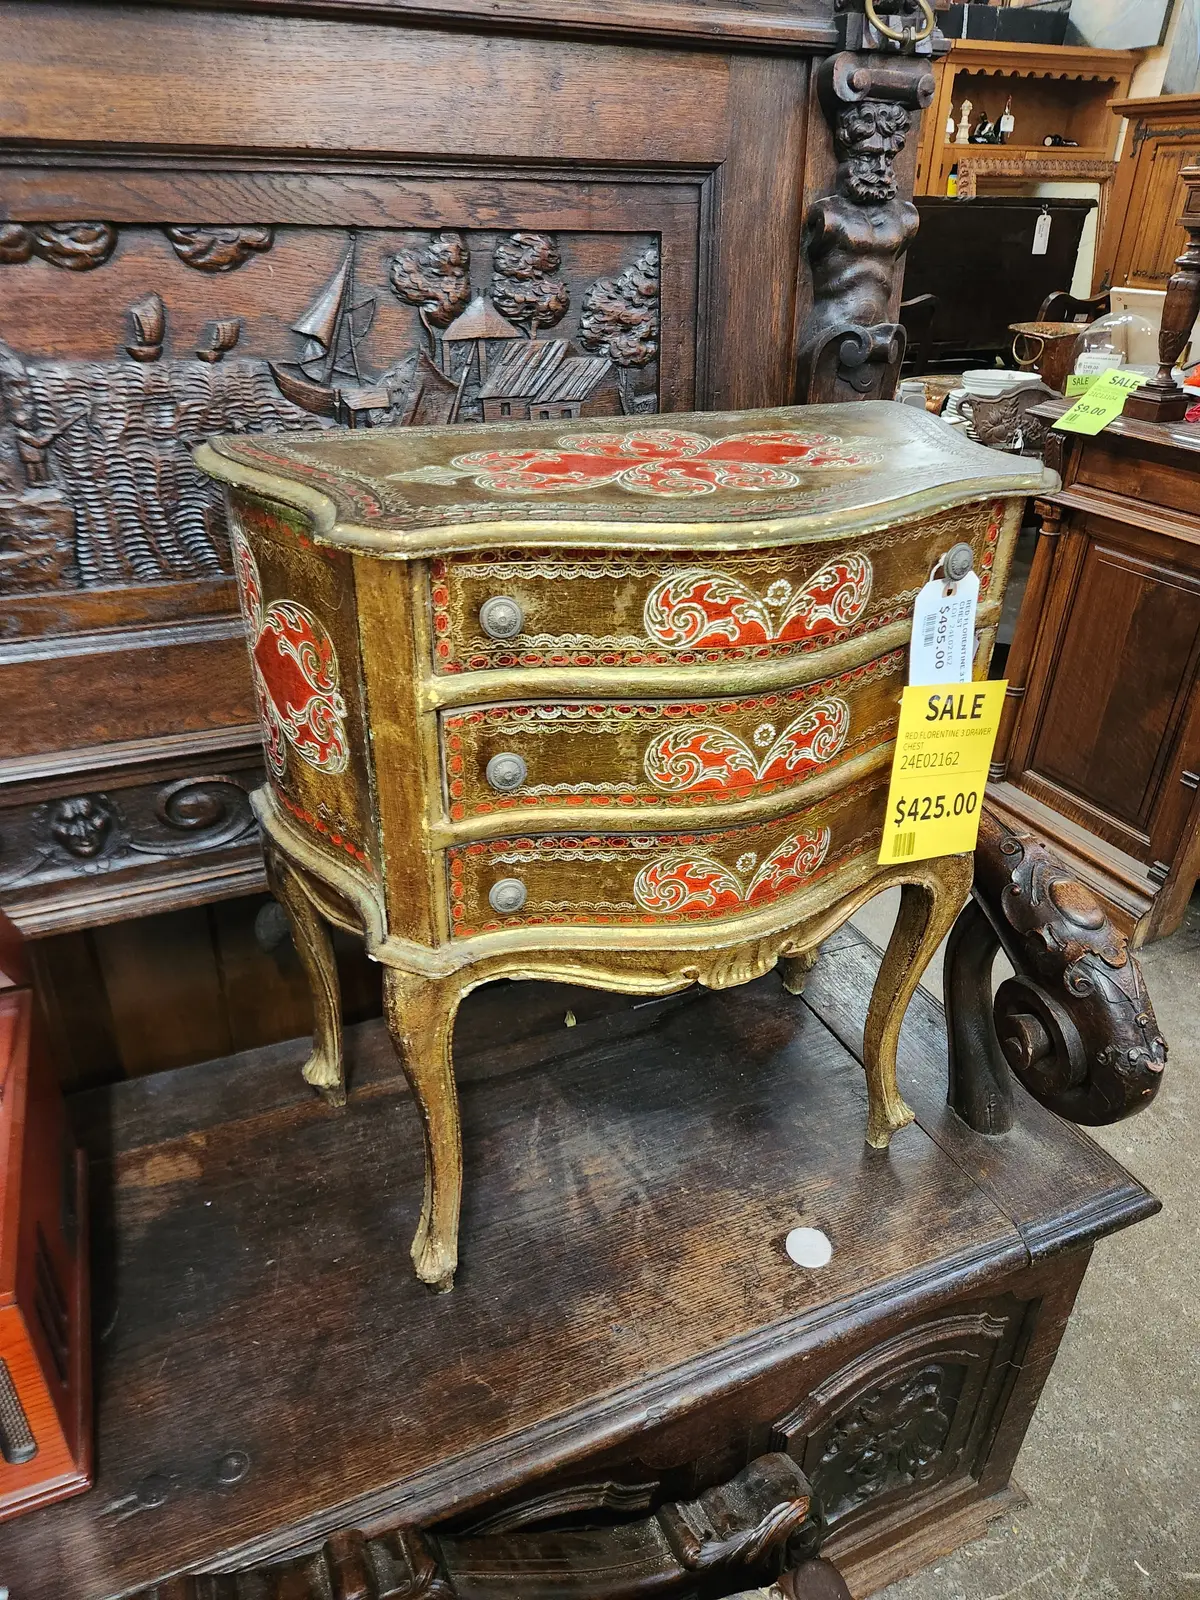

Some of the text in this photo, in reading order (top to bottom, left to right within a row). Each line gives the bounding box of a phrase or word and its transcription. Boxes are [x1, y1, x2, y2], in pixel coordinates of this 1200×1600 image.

[1072, 377, 1090, 386] SALE
[1109, 376, 1140, 389] SALE
[1074, 403, 1106, 416] $9.00
[957, 601, 965, 628] CHEST
[935, 605, 951, 670] $495.00
[960, 617, 969, 670] FLORENTINE
[925, 693, 986, 721] SALE
[905, 727, 992, 740] RED FLORENTINE 3 DRAWER
[903, 741, 925, 751] CHEST
[900, 751, 960, 770] 24E02162
[893, 791, 978, 828] $425.00
